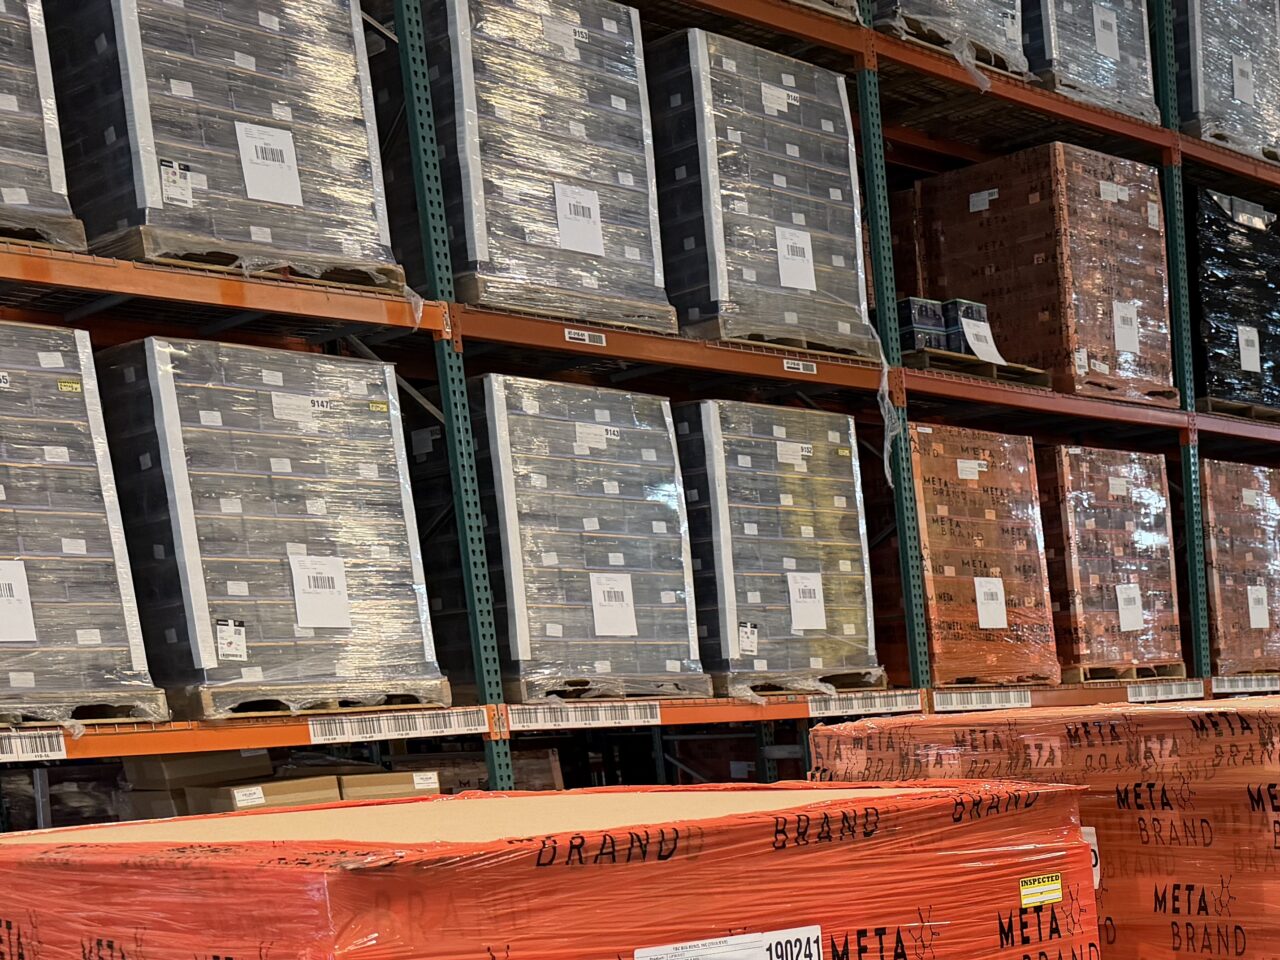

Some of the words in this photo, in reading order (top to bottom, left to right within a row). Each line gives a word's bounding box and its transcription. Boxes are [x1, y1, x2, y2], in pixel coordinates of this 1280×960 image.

[310, 400, 329, 409] 9147
[924, 476, 948, 486] META
[932, 517, 961, 529] META
[1065, 721, 1118, 748] META
[1191, 712, 1252, 739] META
[1116, 782, 1173, 810] META
[772, 807, 880, 851] BRAND
[1138, 817, 1213, 848] BRAND
[1021, 874, 1060, 887] INSPECTED
[1154, 882, 1208, 916] META
[998, 904, 1062, 949] META
[1171, 921, 1246, 957] BRAND
